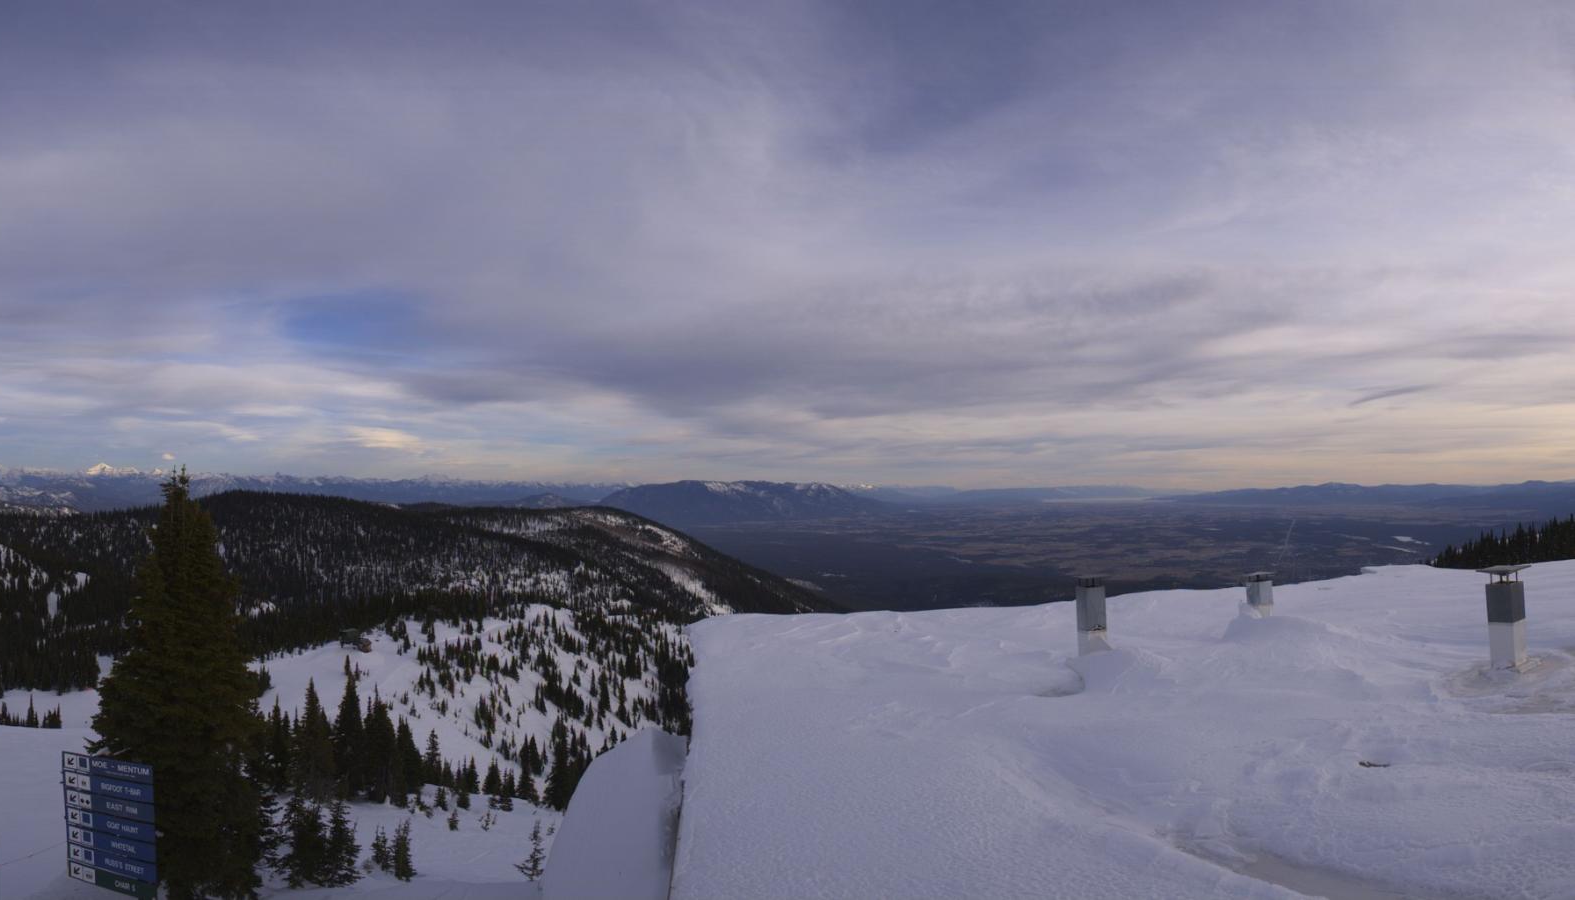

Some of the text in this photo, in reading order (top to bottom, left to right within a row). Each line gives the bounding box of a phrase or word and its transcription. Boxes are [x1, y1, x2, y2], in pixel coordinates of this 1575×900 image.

[92, 760, 107, 769] MOE
[117, 764, 149, 775] MENTUM
[100, 783, 141, 796] BIGFOOT T-BAR
[106, 802, 138, 814] EAST RIM
[106, 820, 121, 830] GOAT
[126, 864, 144, 875] STREET
[114, 880, 130, 891] CHAIR
